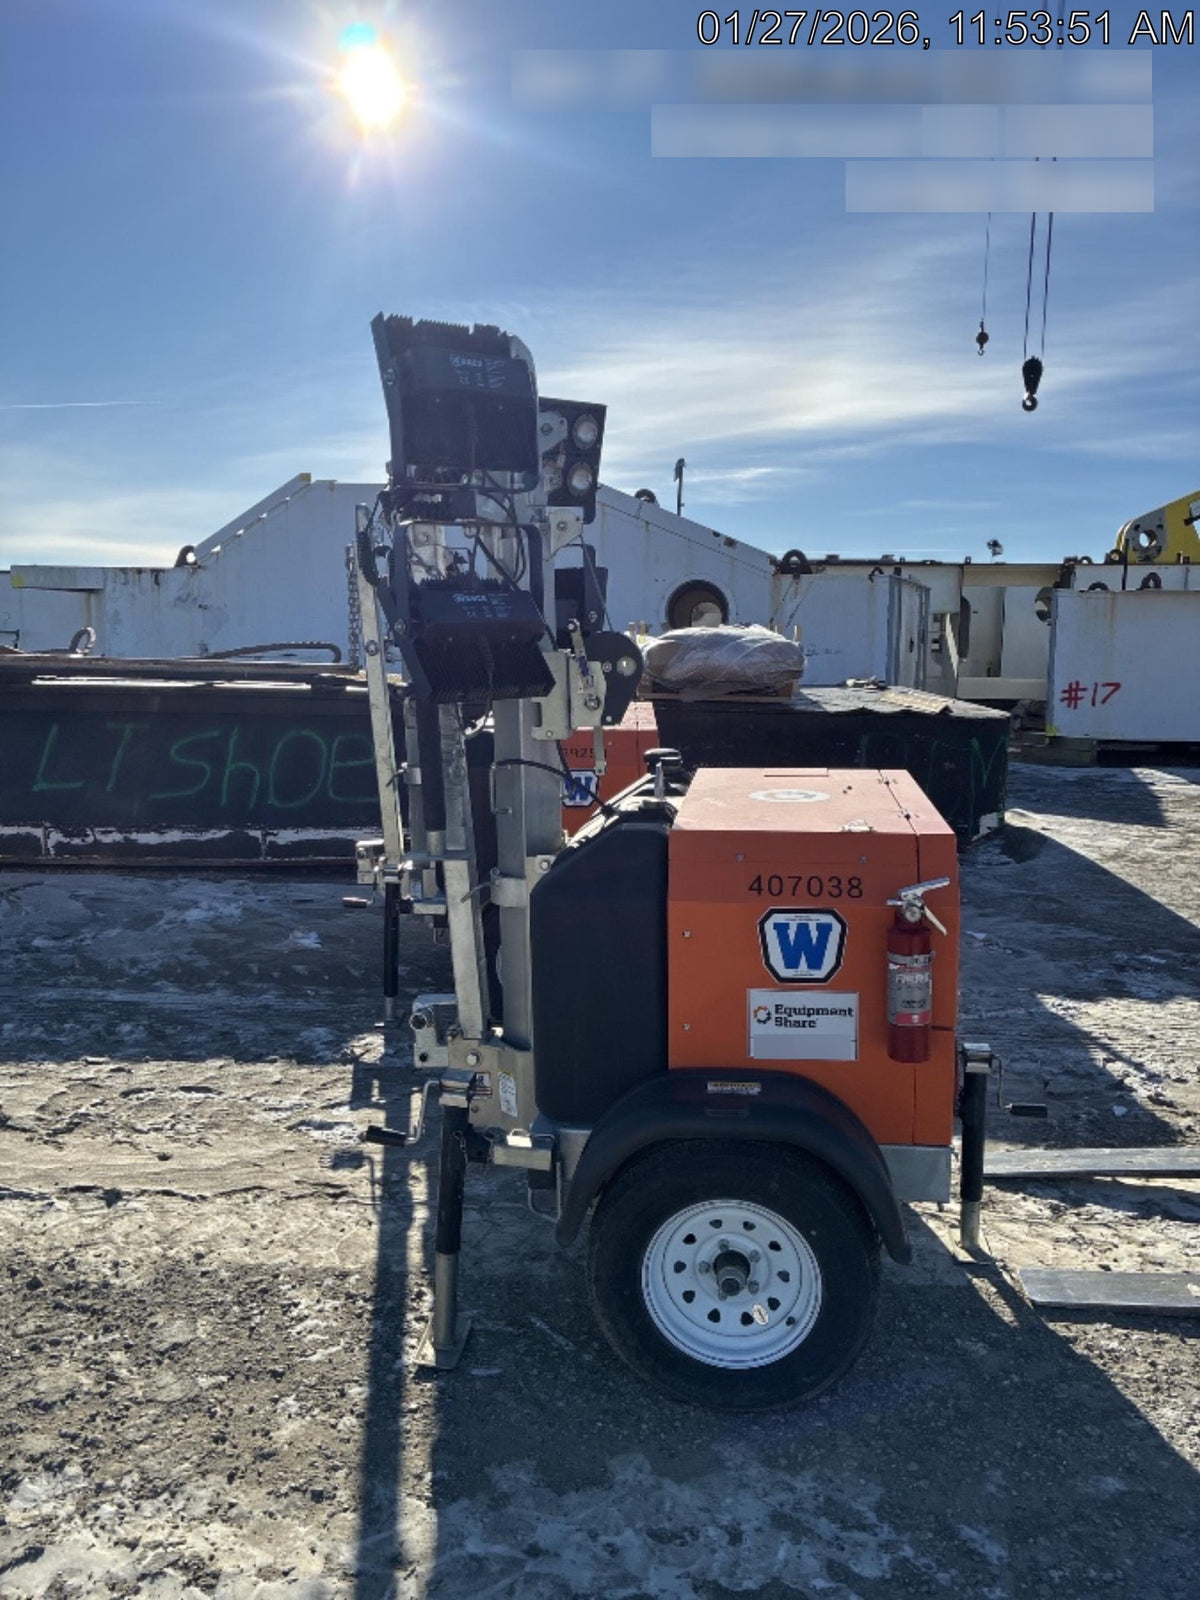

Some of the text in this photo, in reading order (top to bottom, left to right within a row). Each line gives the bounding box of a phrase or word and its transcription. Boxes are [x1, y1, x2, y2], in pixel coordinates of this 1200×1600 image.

[1060, 681, 1121, 709] #17
[748, 875, 864, 898] 407038
[773, 922, 833, 970] W
[774, 1004, 855, 1018] Equipment
[774, 1016, 817, 1028] Share
